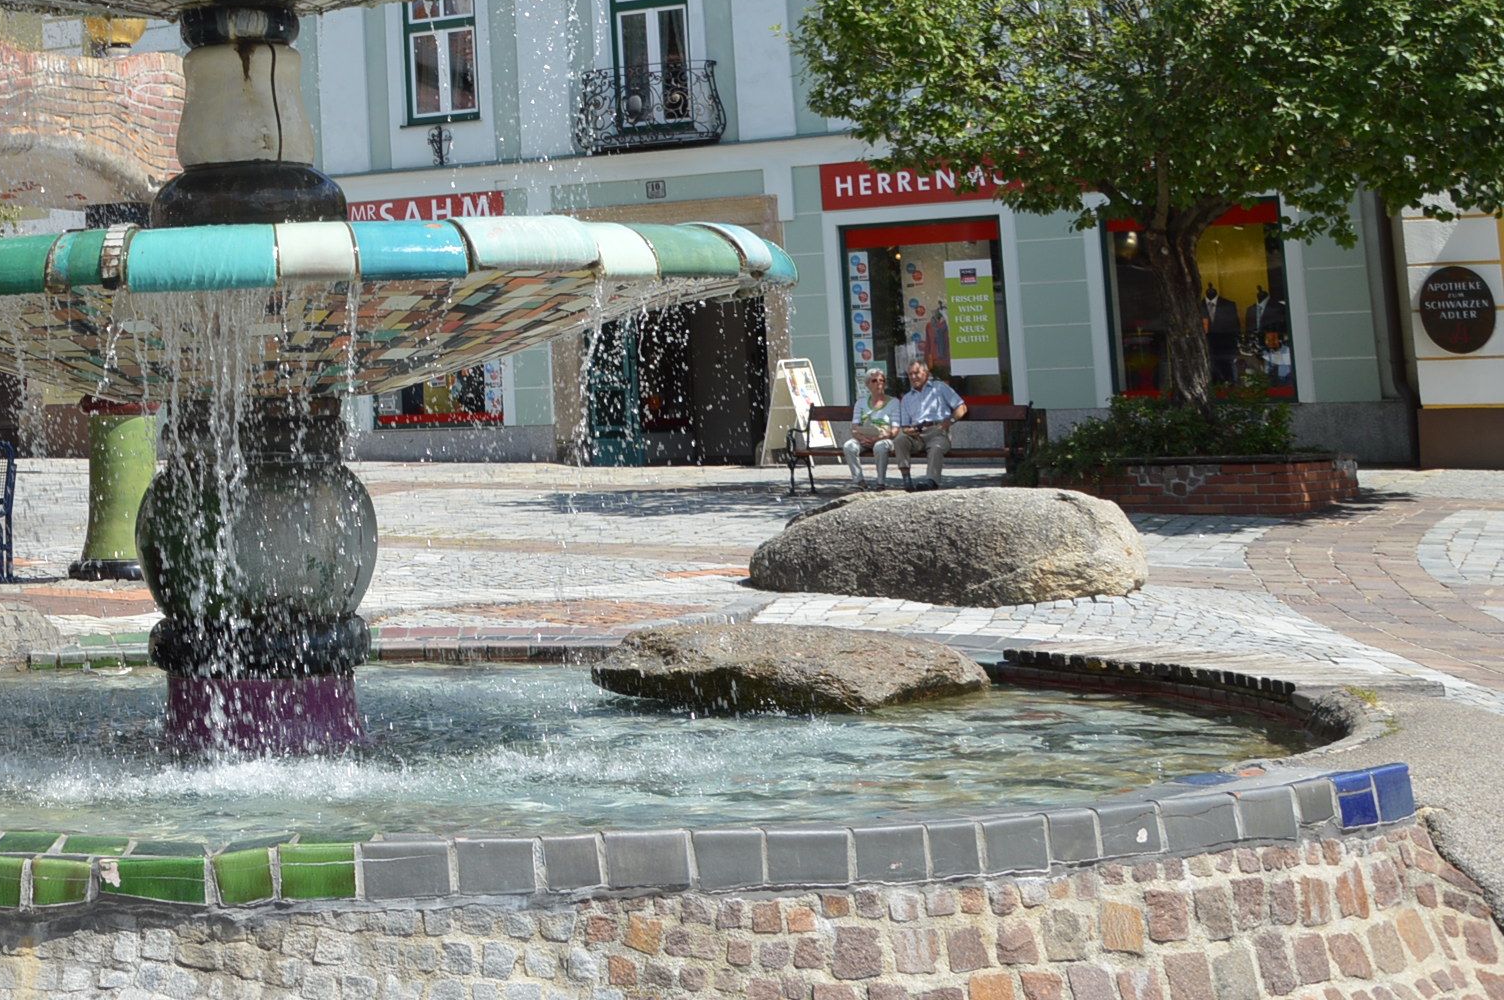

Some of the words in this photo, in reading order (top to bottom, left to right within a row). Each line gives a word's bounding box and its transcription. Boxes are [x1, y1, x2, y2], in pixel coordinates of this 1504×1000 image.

[380, 195, 491, 221] SAHM
[1428, 281, 1481, 291] APOTHEKE
[951, 294, 990, 303] FRISCHER
[958, 304, 983, 313] WIND
[1425, 300, 1488, 309] SCHWARZEN
[955, 313, 973, 323] FÜR
[974, 313, 989, 322] IHR
[1440, 310, 1477, 319] ADLER
[959, 324, 986, 333] NEUES
[956, 335, 989, 344] OUTFIT!
